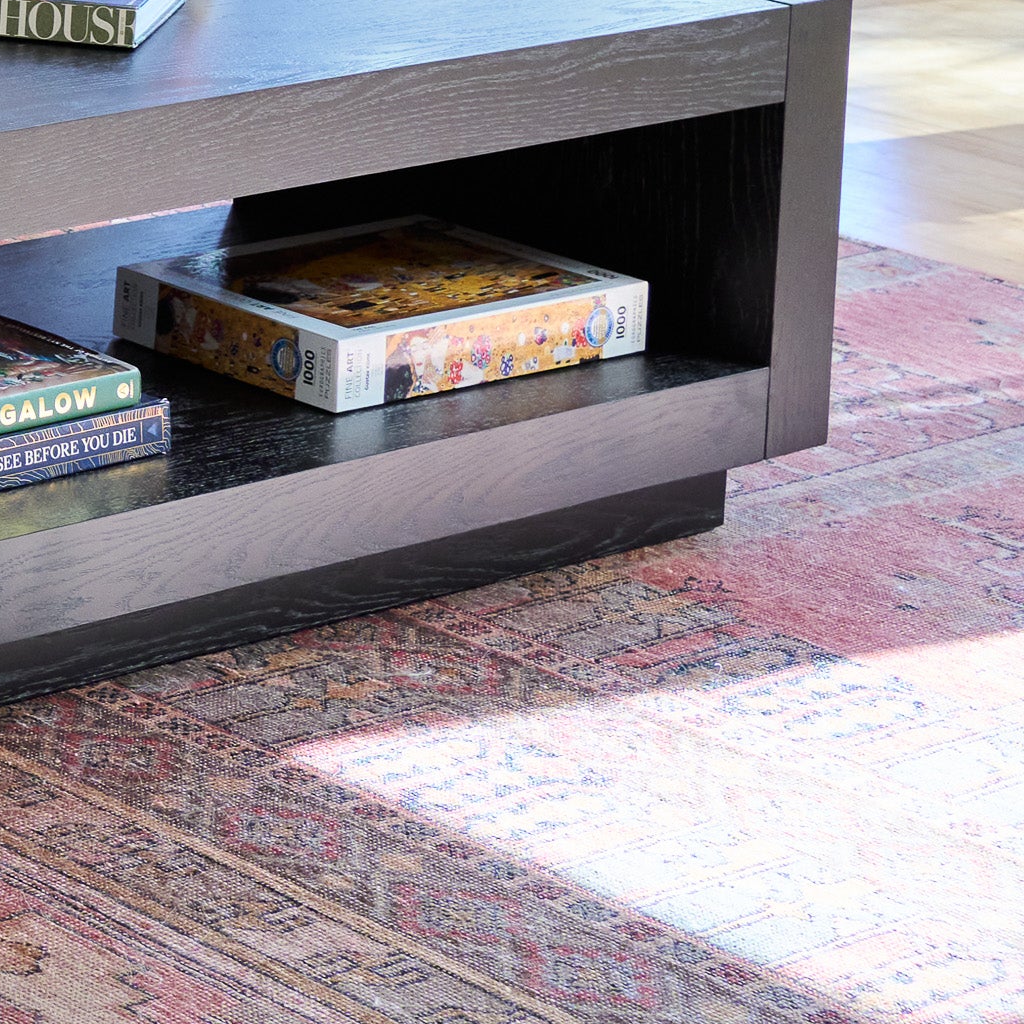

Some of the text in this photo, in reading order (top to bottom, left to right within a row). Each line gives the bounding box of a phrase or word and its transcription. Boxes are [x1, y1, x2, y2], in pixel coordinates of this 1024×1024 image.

[616, 306, 626, 339] 1000
[303, 349, 315, 386] 1000
[344, 377, 353, 400] FINE
[24, 440, 80, 467] BEFORE
[81, 432, 110, 454] YOU
[113, 426, 137, 446] DIE
